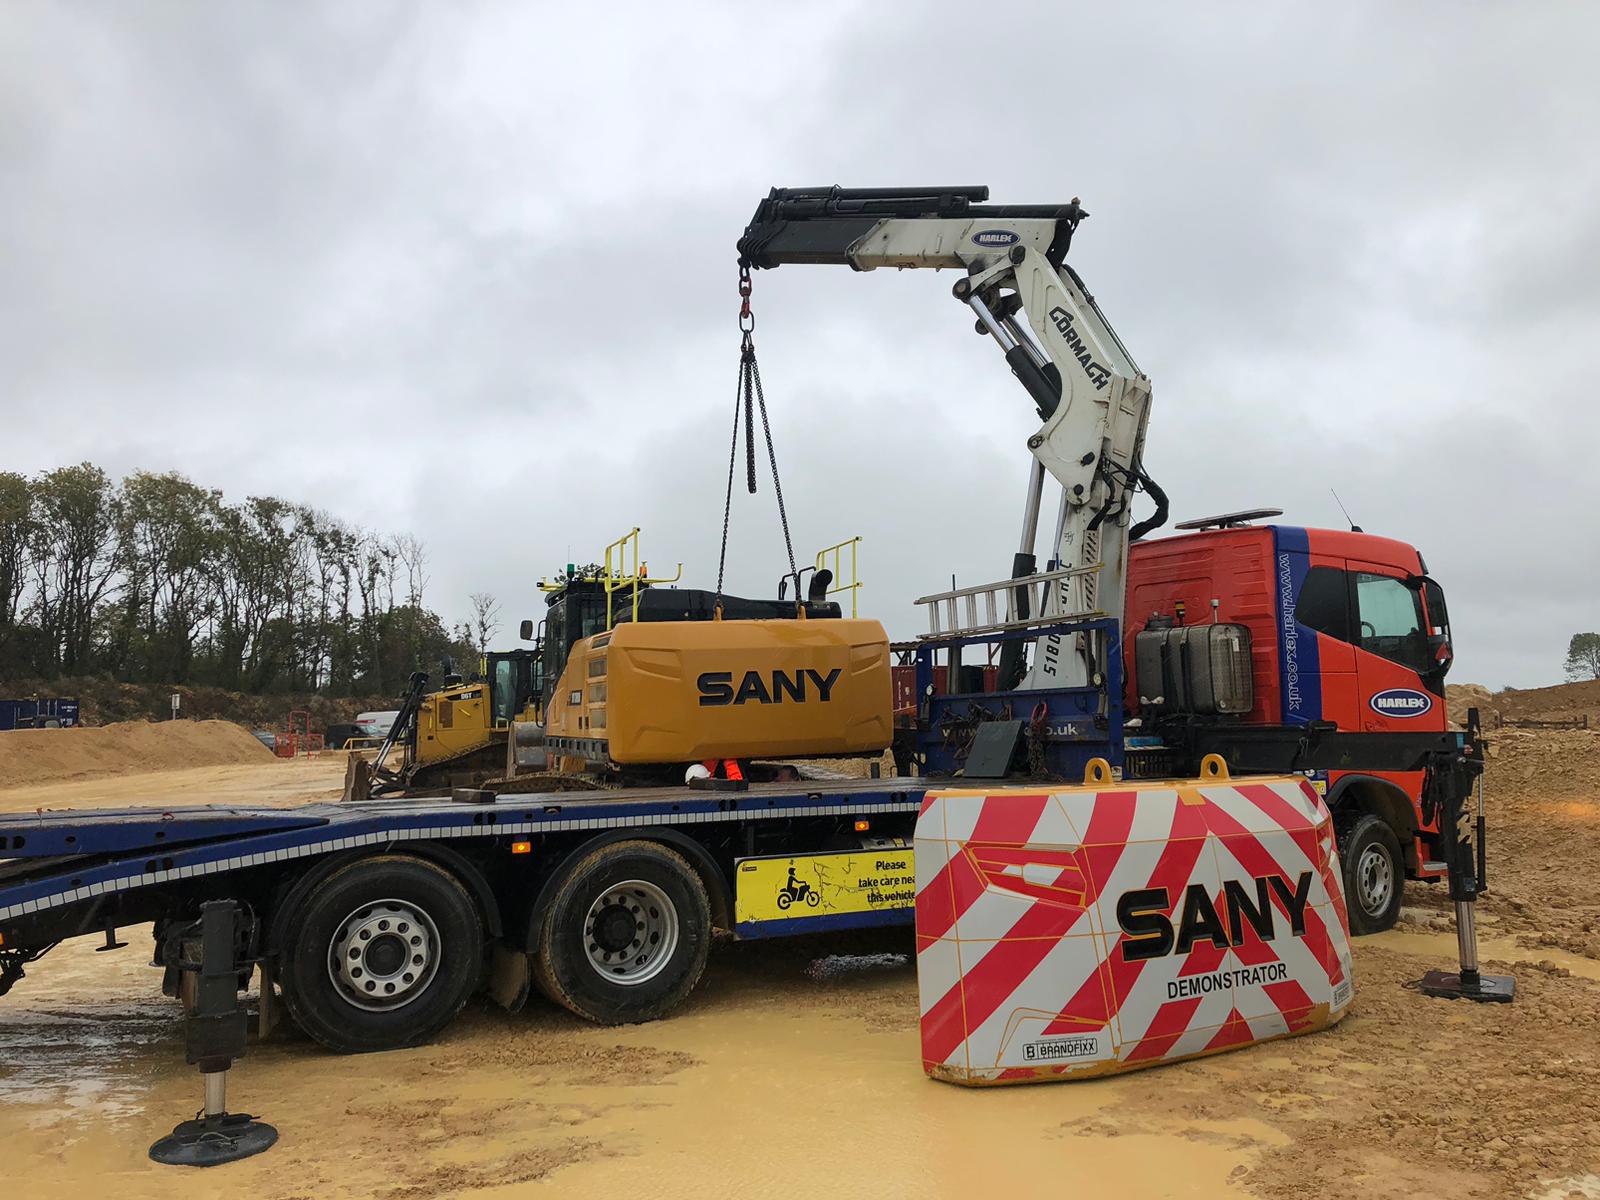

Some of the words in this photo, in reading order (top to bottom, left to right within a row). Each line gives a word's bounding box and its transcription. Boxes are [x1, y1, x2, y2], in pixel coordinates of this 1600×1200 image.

[980, 234, 1012, 242] HARLEX
[1049, 306, 1112, 391] CORMACH
[1279, 553, 1302, 711] www.harlex.co.uk
[697, 668, 842, 706] SANY
[1378, 698, 1425, 708] HARLEX
[876, 861, 906, 870] Please
[858, 877, 879, 888] take
[880, 877, 900, 886] care
[901, 875, 915, 885] nea
[1116, 871, 1313, 962] SANY
[1167, 962, 1288, 999] DEMONSTRATOR
[1040, 1041, 1095, 1056] BRANDFIXX
